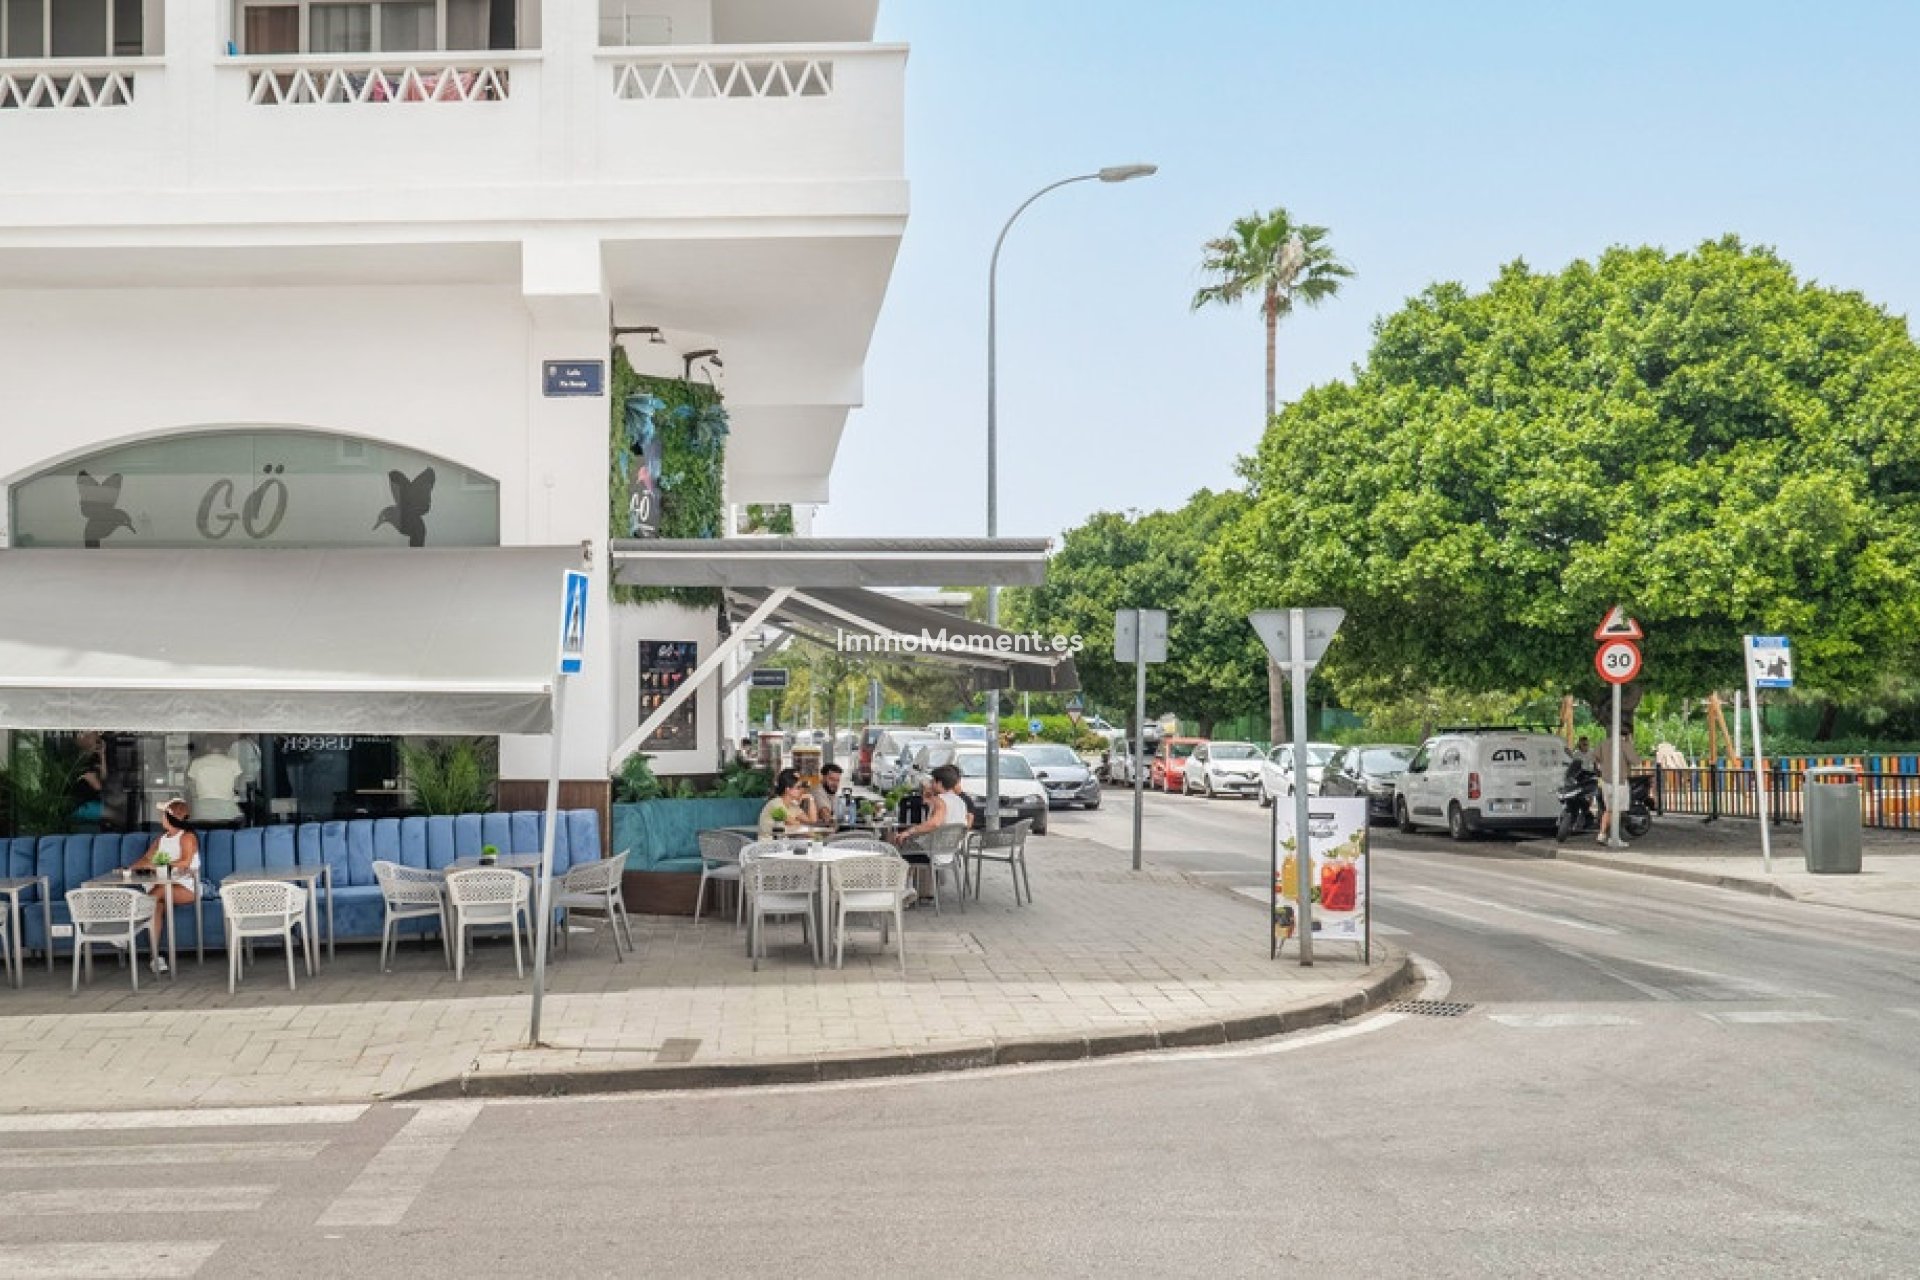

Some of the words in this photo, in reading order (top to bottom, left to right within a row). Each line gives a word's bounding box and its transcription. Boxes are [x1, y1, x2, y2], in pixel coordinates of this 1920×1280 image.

[196, 463, 288, 539] GÖ
[1607, 653, 1631, 669] 30
[1491, 749, 1527, 762] GTA
